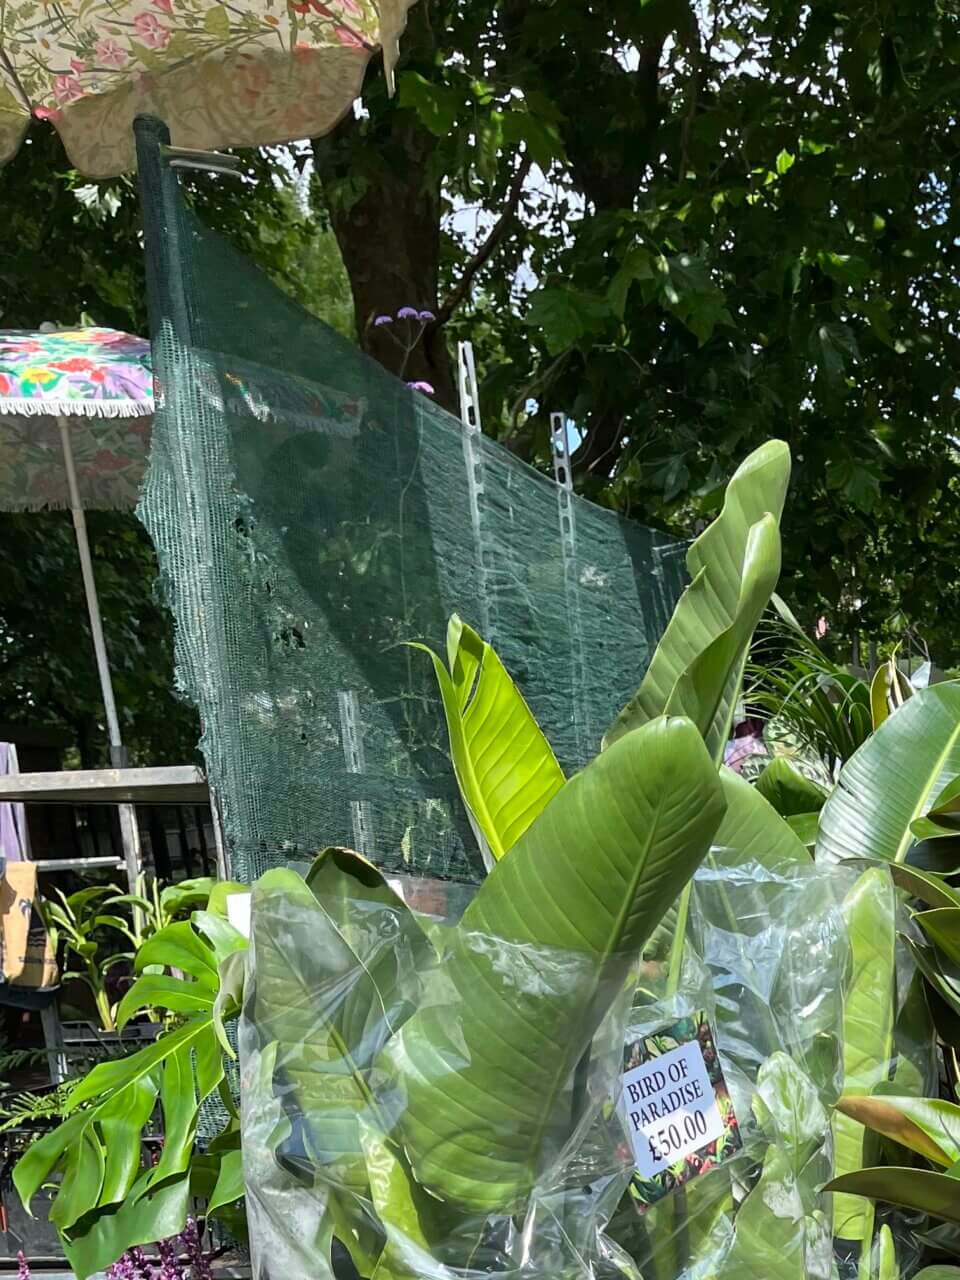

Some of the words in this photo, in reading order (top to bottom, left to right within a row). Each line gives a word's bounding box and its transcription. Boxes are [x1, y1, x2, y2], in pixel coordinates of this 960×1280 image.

[627, 1071, 666, 1104] BIRD
[668, 1058, 688, 1082] OF
[630, 1079, 704, 1131] PARADISE
[648, 1110, 707, 1163] £50.00
